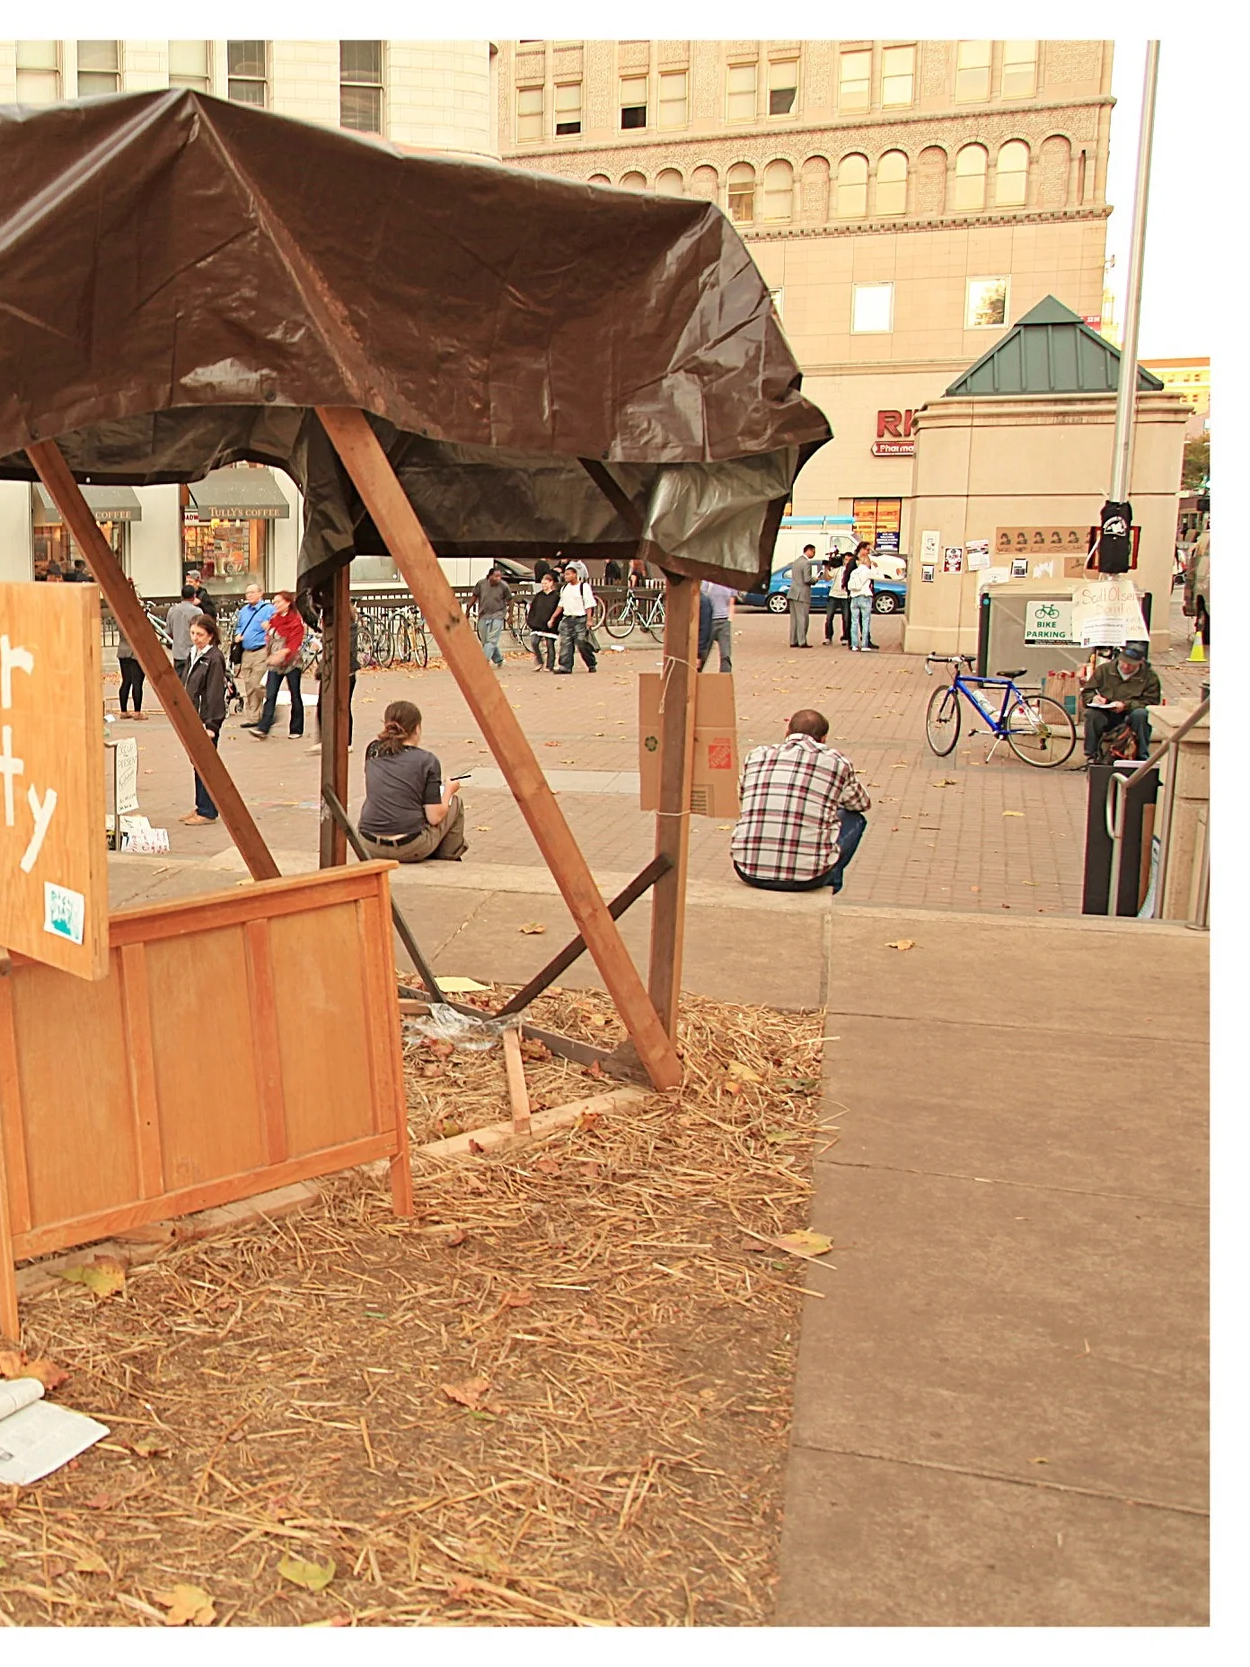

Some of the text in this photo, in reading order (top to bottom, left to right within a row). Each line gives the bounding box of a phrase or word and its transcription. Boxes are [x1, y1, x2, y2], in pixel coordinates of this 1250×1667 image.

[877, 409, 919, 438] RI
[95, 511, 132, 519] COFFEE
[245, 508, 280, 517] COFFEE
